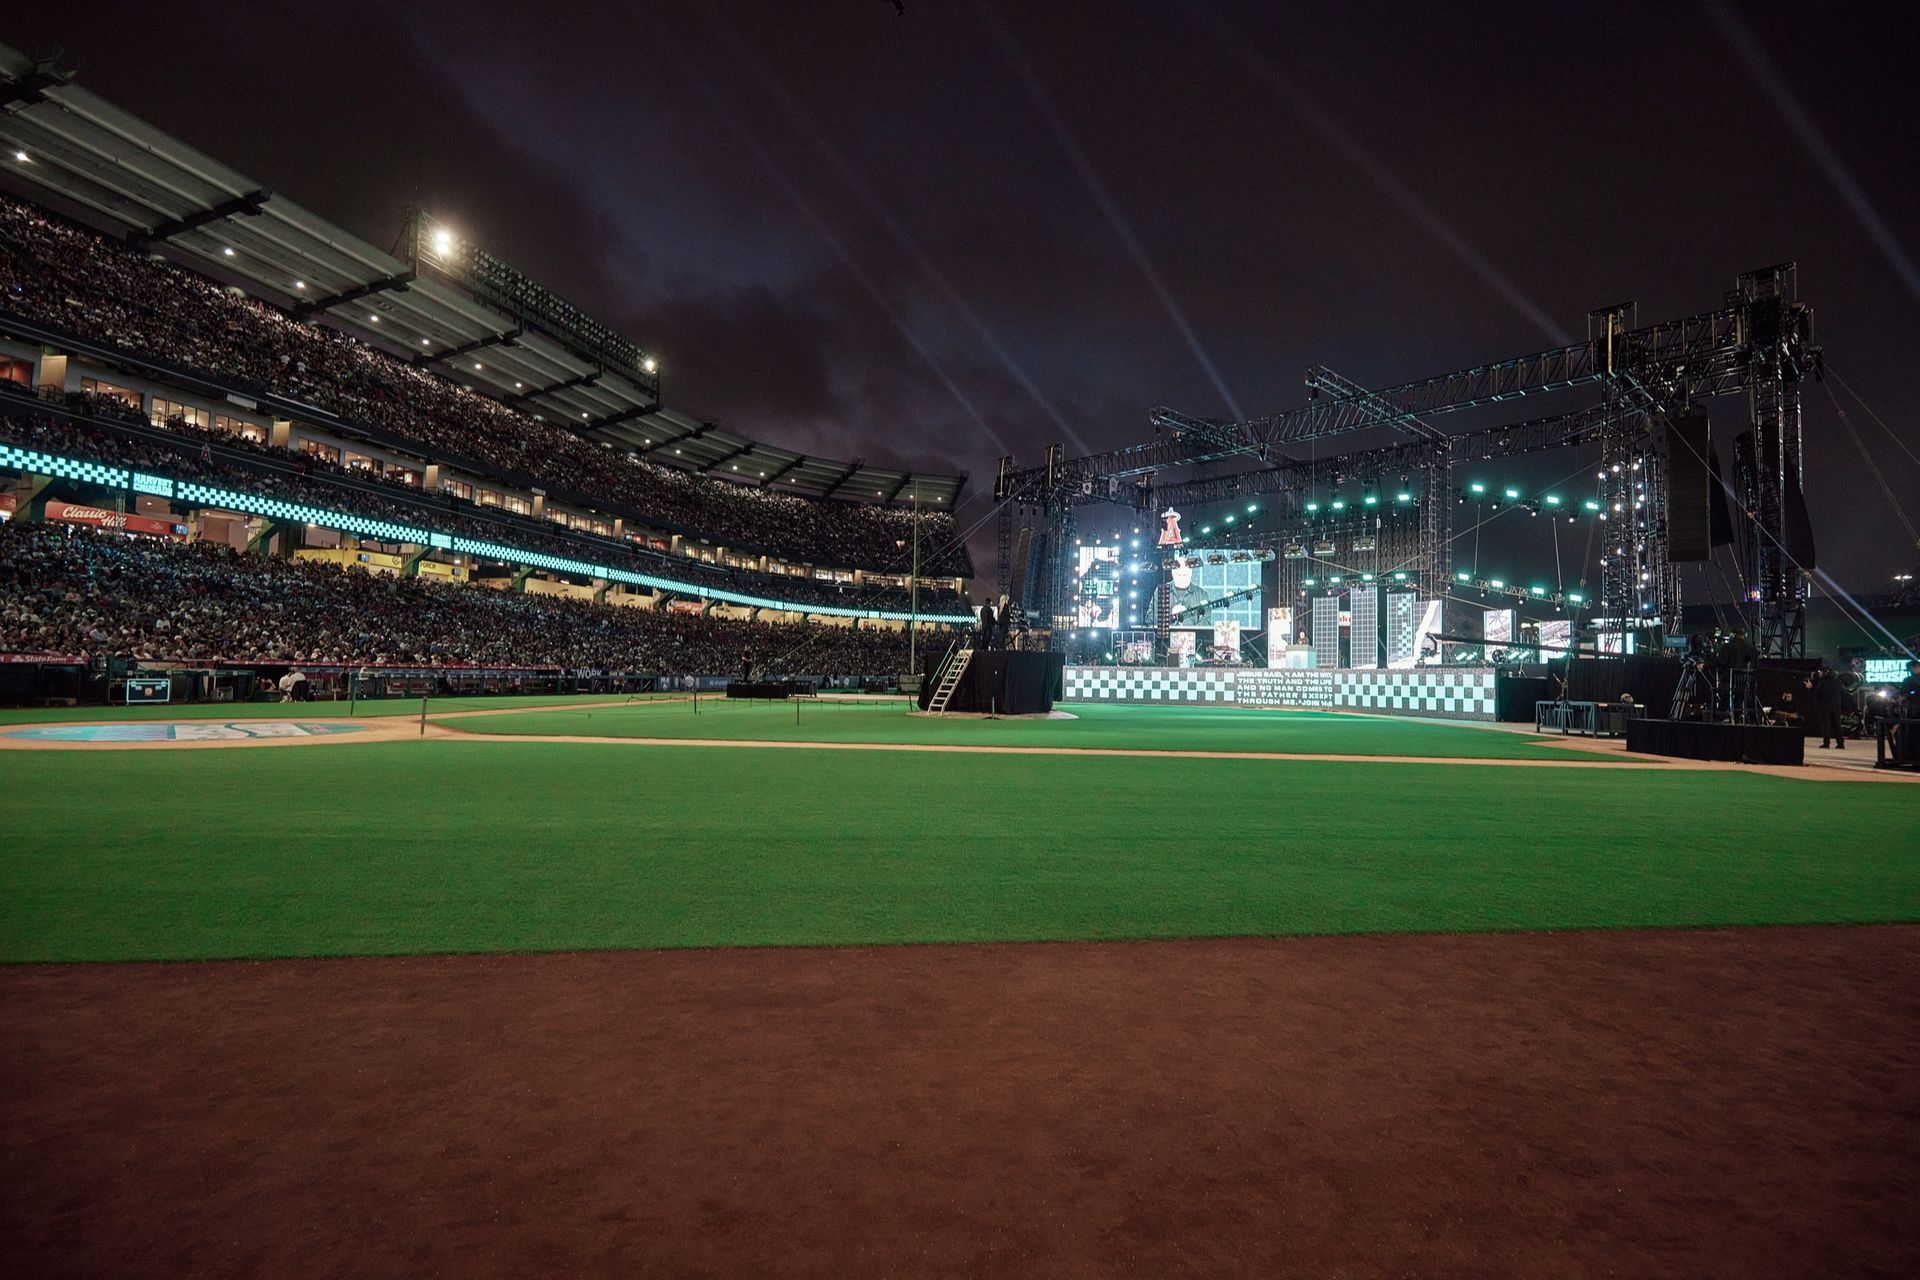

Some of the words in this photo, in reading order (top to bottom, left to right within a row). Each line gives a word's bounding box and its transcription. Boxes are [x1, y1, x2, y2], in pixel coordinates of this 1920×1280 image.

[134, 472, 173, 488] HARVEST
[133, 482, 173, 497] CRUSADE
[62, 506, 107, 519] Classic
